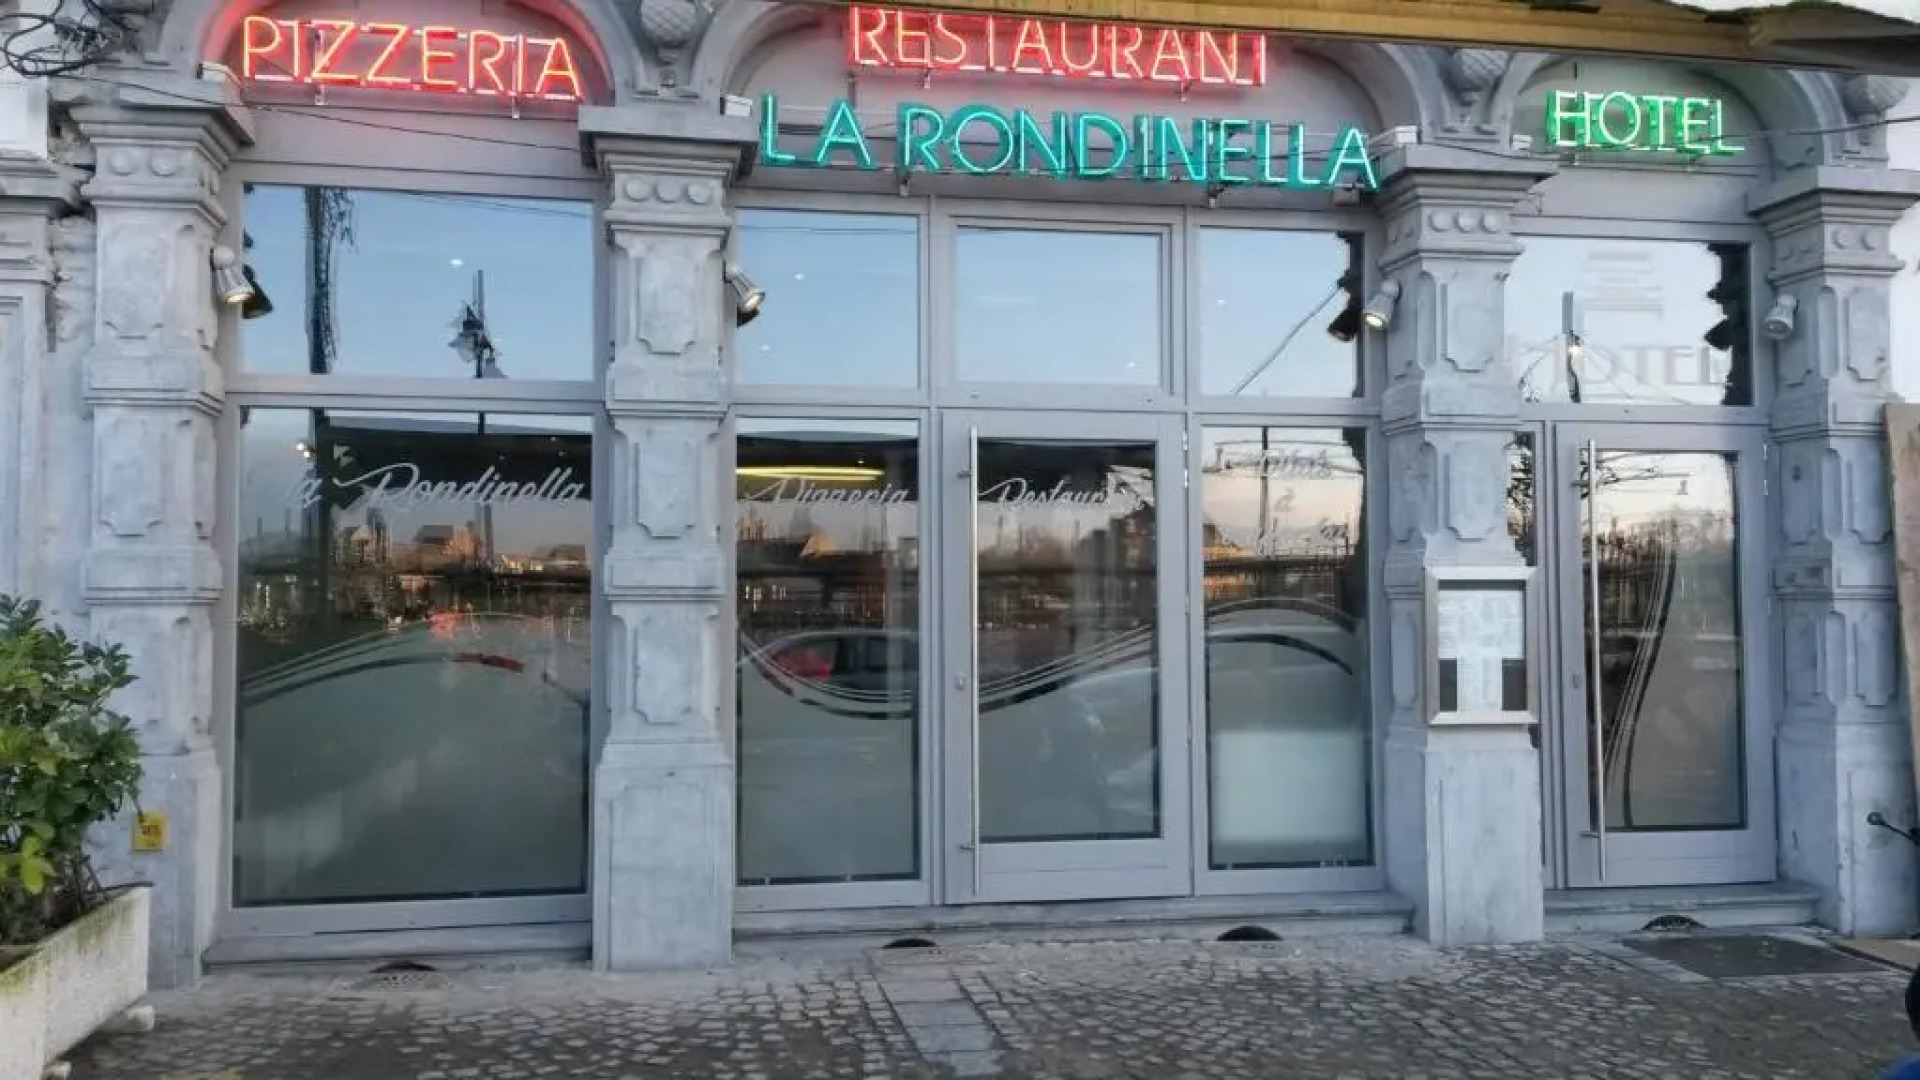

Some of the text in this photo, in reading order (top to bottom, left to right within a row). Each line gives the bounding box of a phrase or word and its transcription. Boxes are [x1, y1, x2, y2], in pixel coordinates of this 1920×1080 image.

[242, 15, 583, 101] PIZZERIA
[849, 4, 1267, 86] RESTAURANT
[760, 93, 1381, 191] LA RONDINELLA
[1546, 89, 1746, 155] HOTEL
